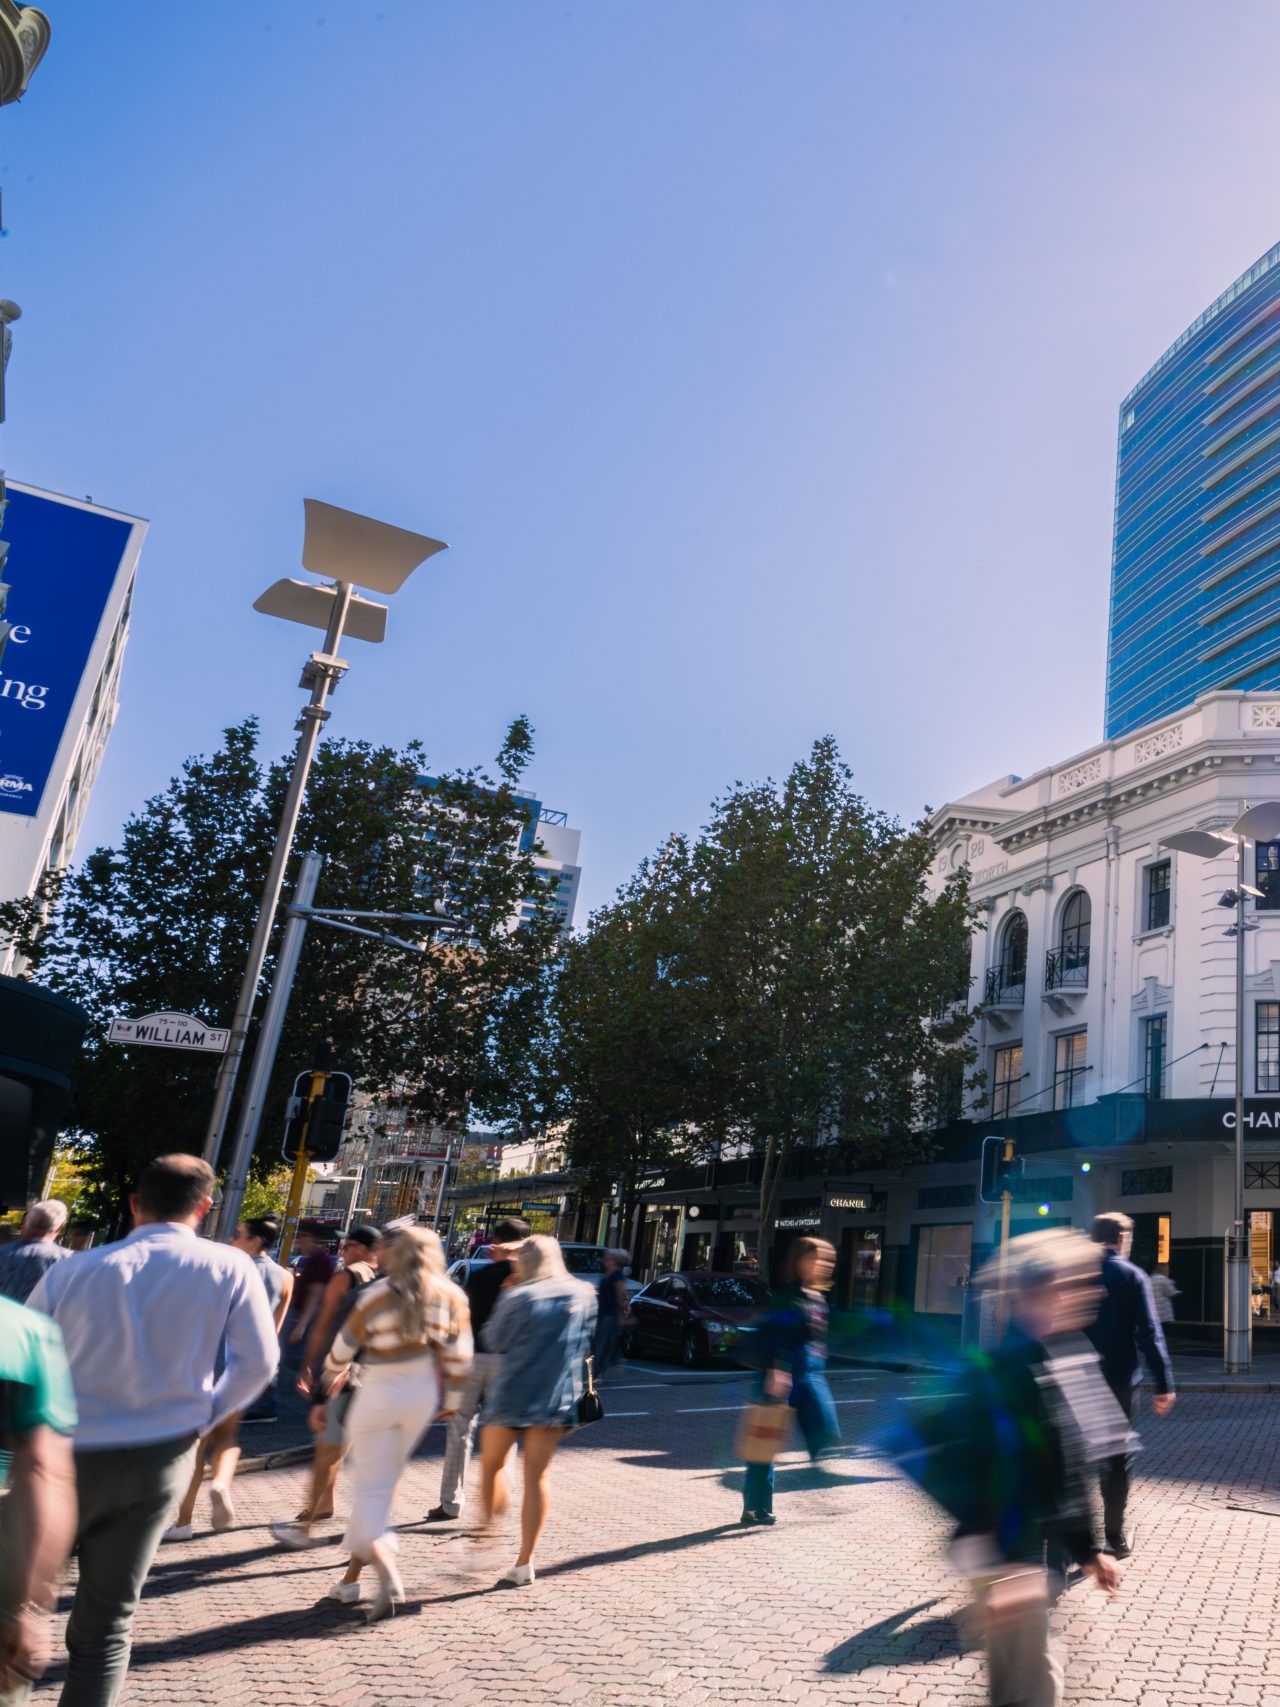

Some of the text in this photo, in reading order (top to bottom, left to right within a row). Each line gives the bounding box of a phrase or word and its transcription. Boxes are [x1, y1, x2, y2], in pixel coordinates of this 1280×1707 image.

[0, 619, 31, 643] e
[939, 839, 985, 872] 19 28
[970, 860, 1008, 885] WORTH
[136, 1025, 223, 1045] WILLIAM ST
[829, 1198, 867, 1209] CHANEL
[864, 1230, 879, 1240] Cartier
